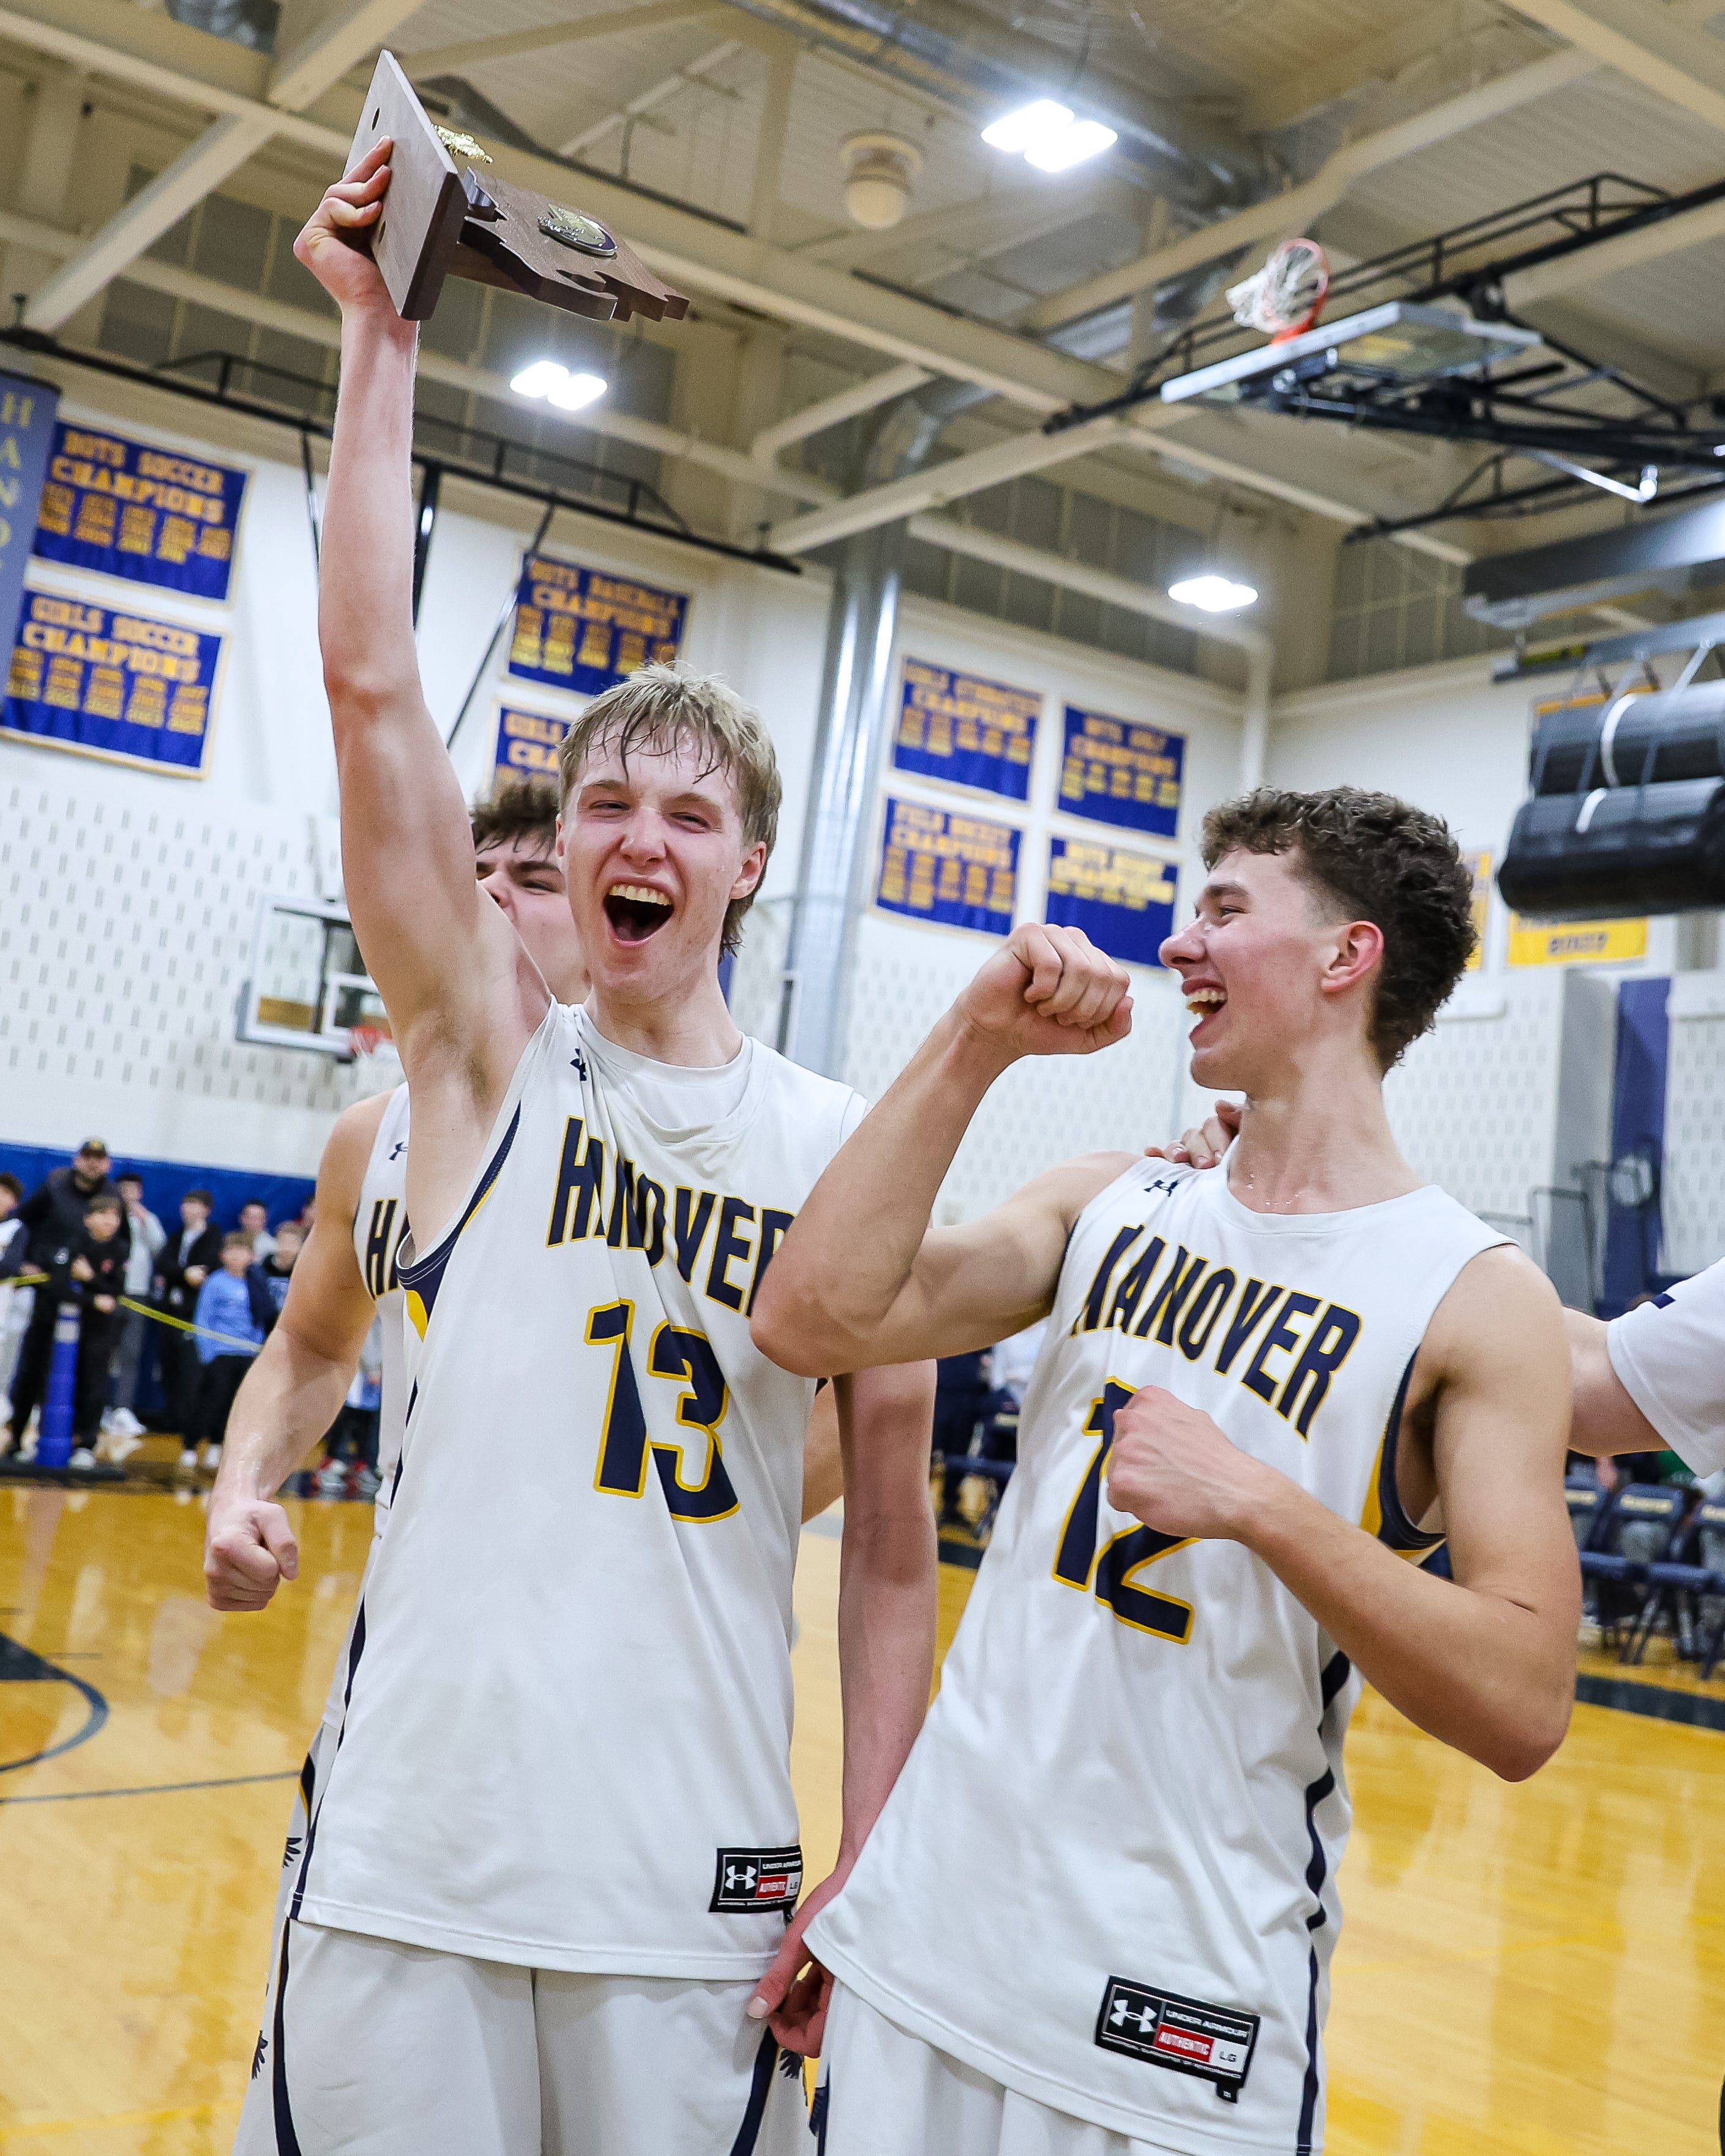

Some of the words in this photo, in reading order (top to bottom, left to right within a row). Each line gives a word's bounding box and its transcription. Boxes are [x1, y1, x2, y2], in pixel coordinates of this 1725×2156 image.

[51, 455, 225, 523] CHAMPIONS
[138, 452, 224, 495] SOCCER
[112, 616, 198, 656] SOCCER
[533, 585, 672, 638] CHAMPIONS
[23, 621, 200, 683] CHAMPIONS
[585, 1298, 741, 1523] 13
[1219, 2051, 1237, 2062] LG
